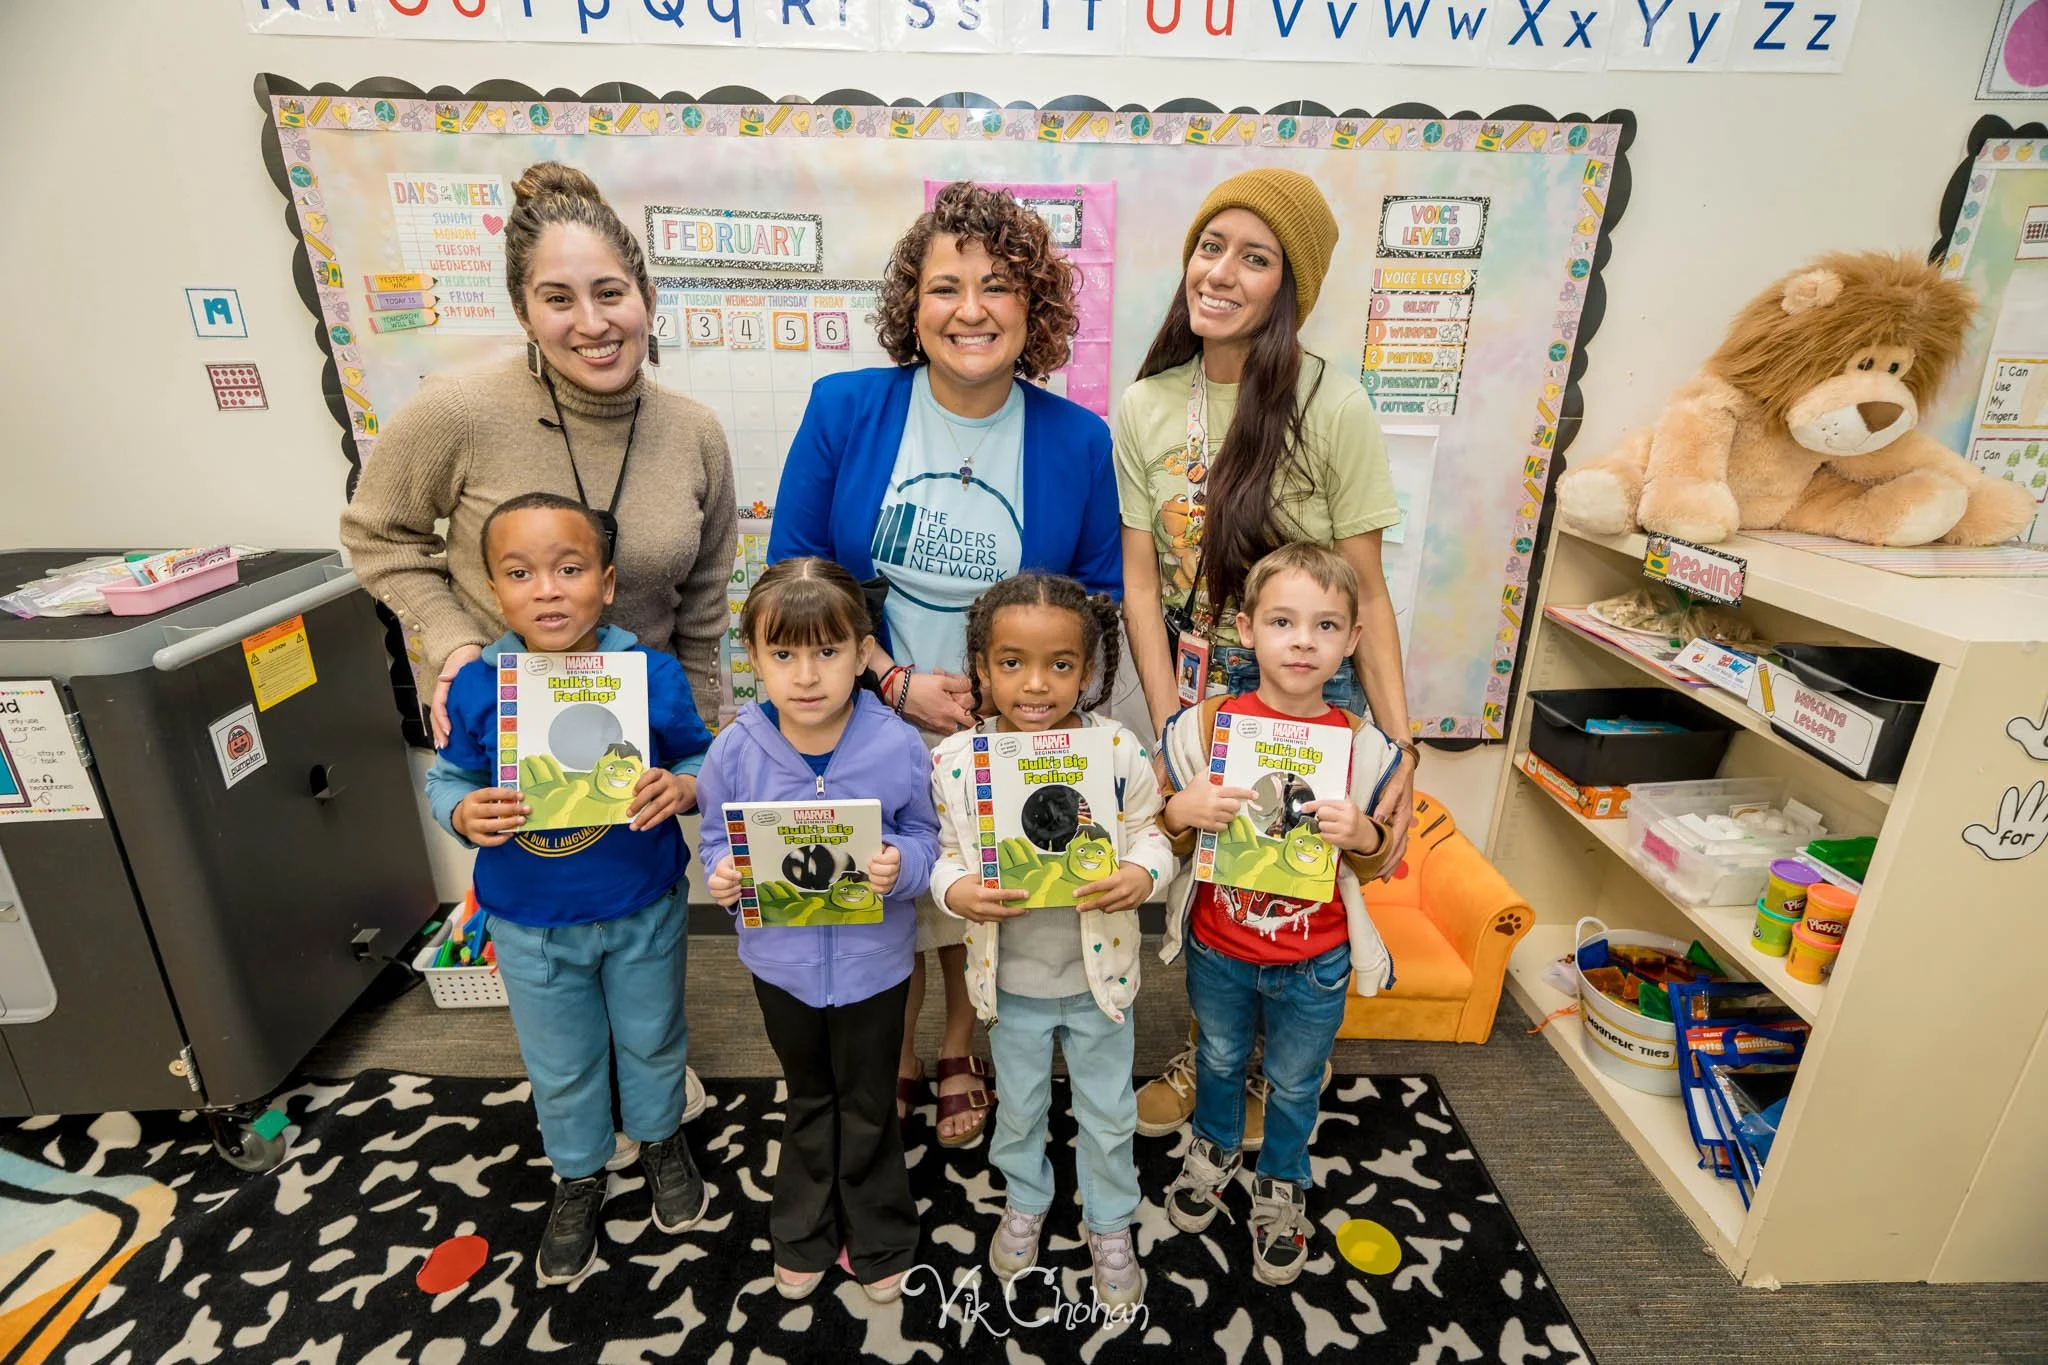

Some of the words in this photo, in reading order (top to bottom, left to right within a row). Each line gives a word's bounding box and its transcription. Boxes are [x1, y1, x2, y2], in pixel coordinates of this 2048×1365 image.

[393, 181, 440, 205] DAYS
[440, 185, 450, 194] OF
[451, 183, 502, 206] WEEK
[433, 212, 473, 225] SUNDAY
[1411, 205, 1459, 225] VOICE
[433, 228, 477, 241] MONDAY
[662, 219, 806, 257] FEBRUARY
[1402, 226, 1460, 246] LEVELS
[436, 244, 481, 257] TUESDAY
[429, 259, 492, 272] WEDNESDAY
[379, 275, 415, 283] YESTERDAY
[437, 275, 491, 288] THURSDAY
[1384, 271, 1417, 285] VOICE
[1421, 271, 1462, 285] LEVELS
[385, 297, 406, 305] TODAY
[450, 291, 485, 303] FRIDAY
[684, 294, 722, 307] TUESDAY
[726, 294, 766, 307] WEDNESDAY
[768, 295, 808, 308] THURSDAY
[814, 295, 845, 308] FRIDAY
[443, 306, 496, 319] SATURDAY
[1375, 299, 1385, 313] 0
[1403, 300, 1440, 314] SILENT
[381, 313, 420, 324] TOMORROW
[390, 320, 406, 329] WILL
[656, 314, 668, 338] 2
[699, 315, 711, 338] 3
[741, 319, 753, 341] 4
[785, 320, 797, 341] 5
[826, 320, 838, 341] 6
[1389, 325, 1438, 339] WHISPER
[1370, 350, 1379, 364] 2
[1387, 351, 1434, 365] PARTNER
[2008, 366, 2029, 377] Can
[1367, 375, 1375, 387] 3
[1995, 382, 2012, 392] Use
[1380, 401, 1425, 414] OUTSIDE
[1990, 396, 2005, 408] My
[1985, 410, 2019, 423] Fingers
[1983, 449, 2001, 461] Can
[919, 506, 949, 525] THE
[917, 521, 997, 548] LEADERS
[913, 537, 997, 567] READERS
[909, 554, 1008, 584] NETWORK
[1667, 549, 1743, 599] Reading
[565, 655, 604, 670] MARVEL
[548, 676, 593, 689] Hulk's
[595, 674, 621, 690] Big
[554, 688, 617, 704] Feelings
[732, 686, 756, 698] 160
[1794, 689, 1848, 728] Matching
[1272, 723, 1310, 740] MARVEL
[1793, 710, 1837, 744] Letters
[1033, 733, 1071, 750] MARVEL
[1254, 741, 1297, 757] Hulk's
[1299, 746, 1323, 764] Big
[231, 752, 261, 777] pumpkin
[1018, 755, 1062, 771] Hulk's
[1063, 753, 1088, 770] Big
[1258, 755, 1316, 775] Feelings
[1024, 769, 1084, 785] Feelings
[794, 808, 835, 821] MARVEL
[530, 833, 551, 848] DUAL
[554, 825, 600, 848] LANGUAG
[777, 825, 825, 836] Hulk's
[827, 823, 854, 836] Big
[784, 834, 849, 845] Feelings
[1999, 829, 2035, 846] for
[1586, 1015, 1635, 1053] Magnetic
[1639, 1044, 1670, 1060] Tiles
